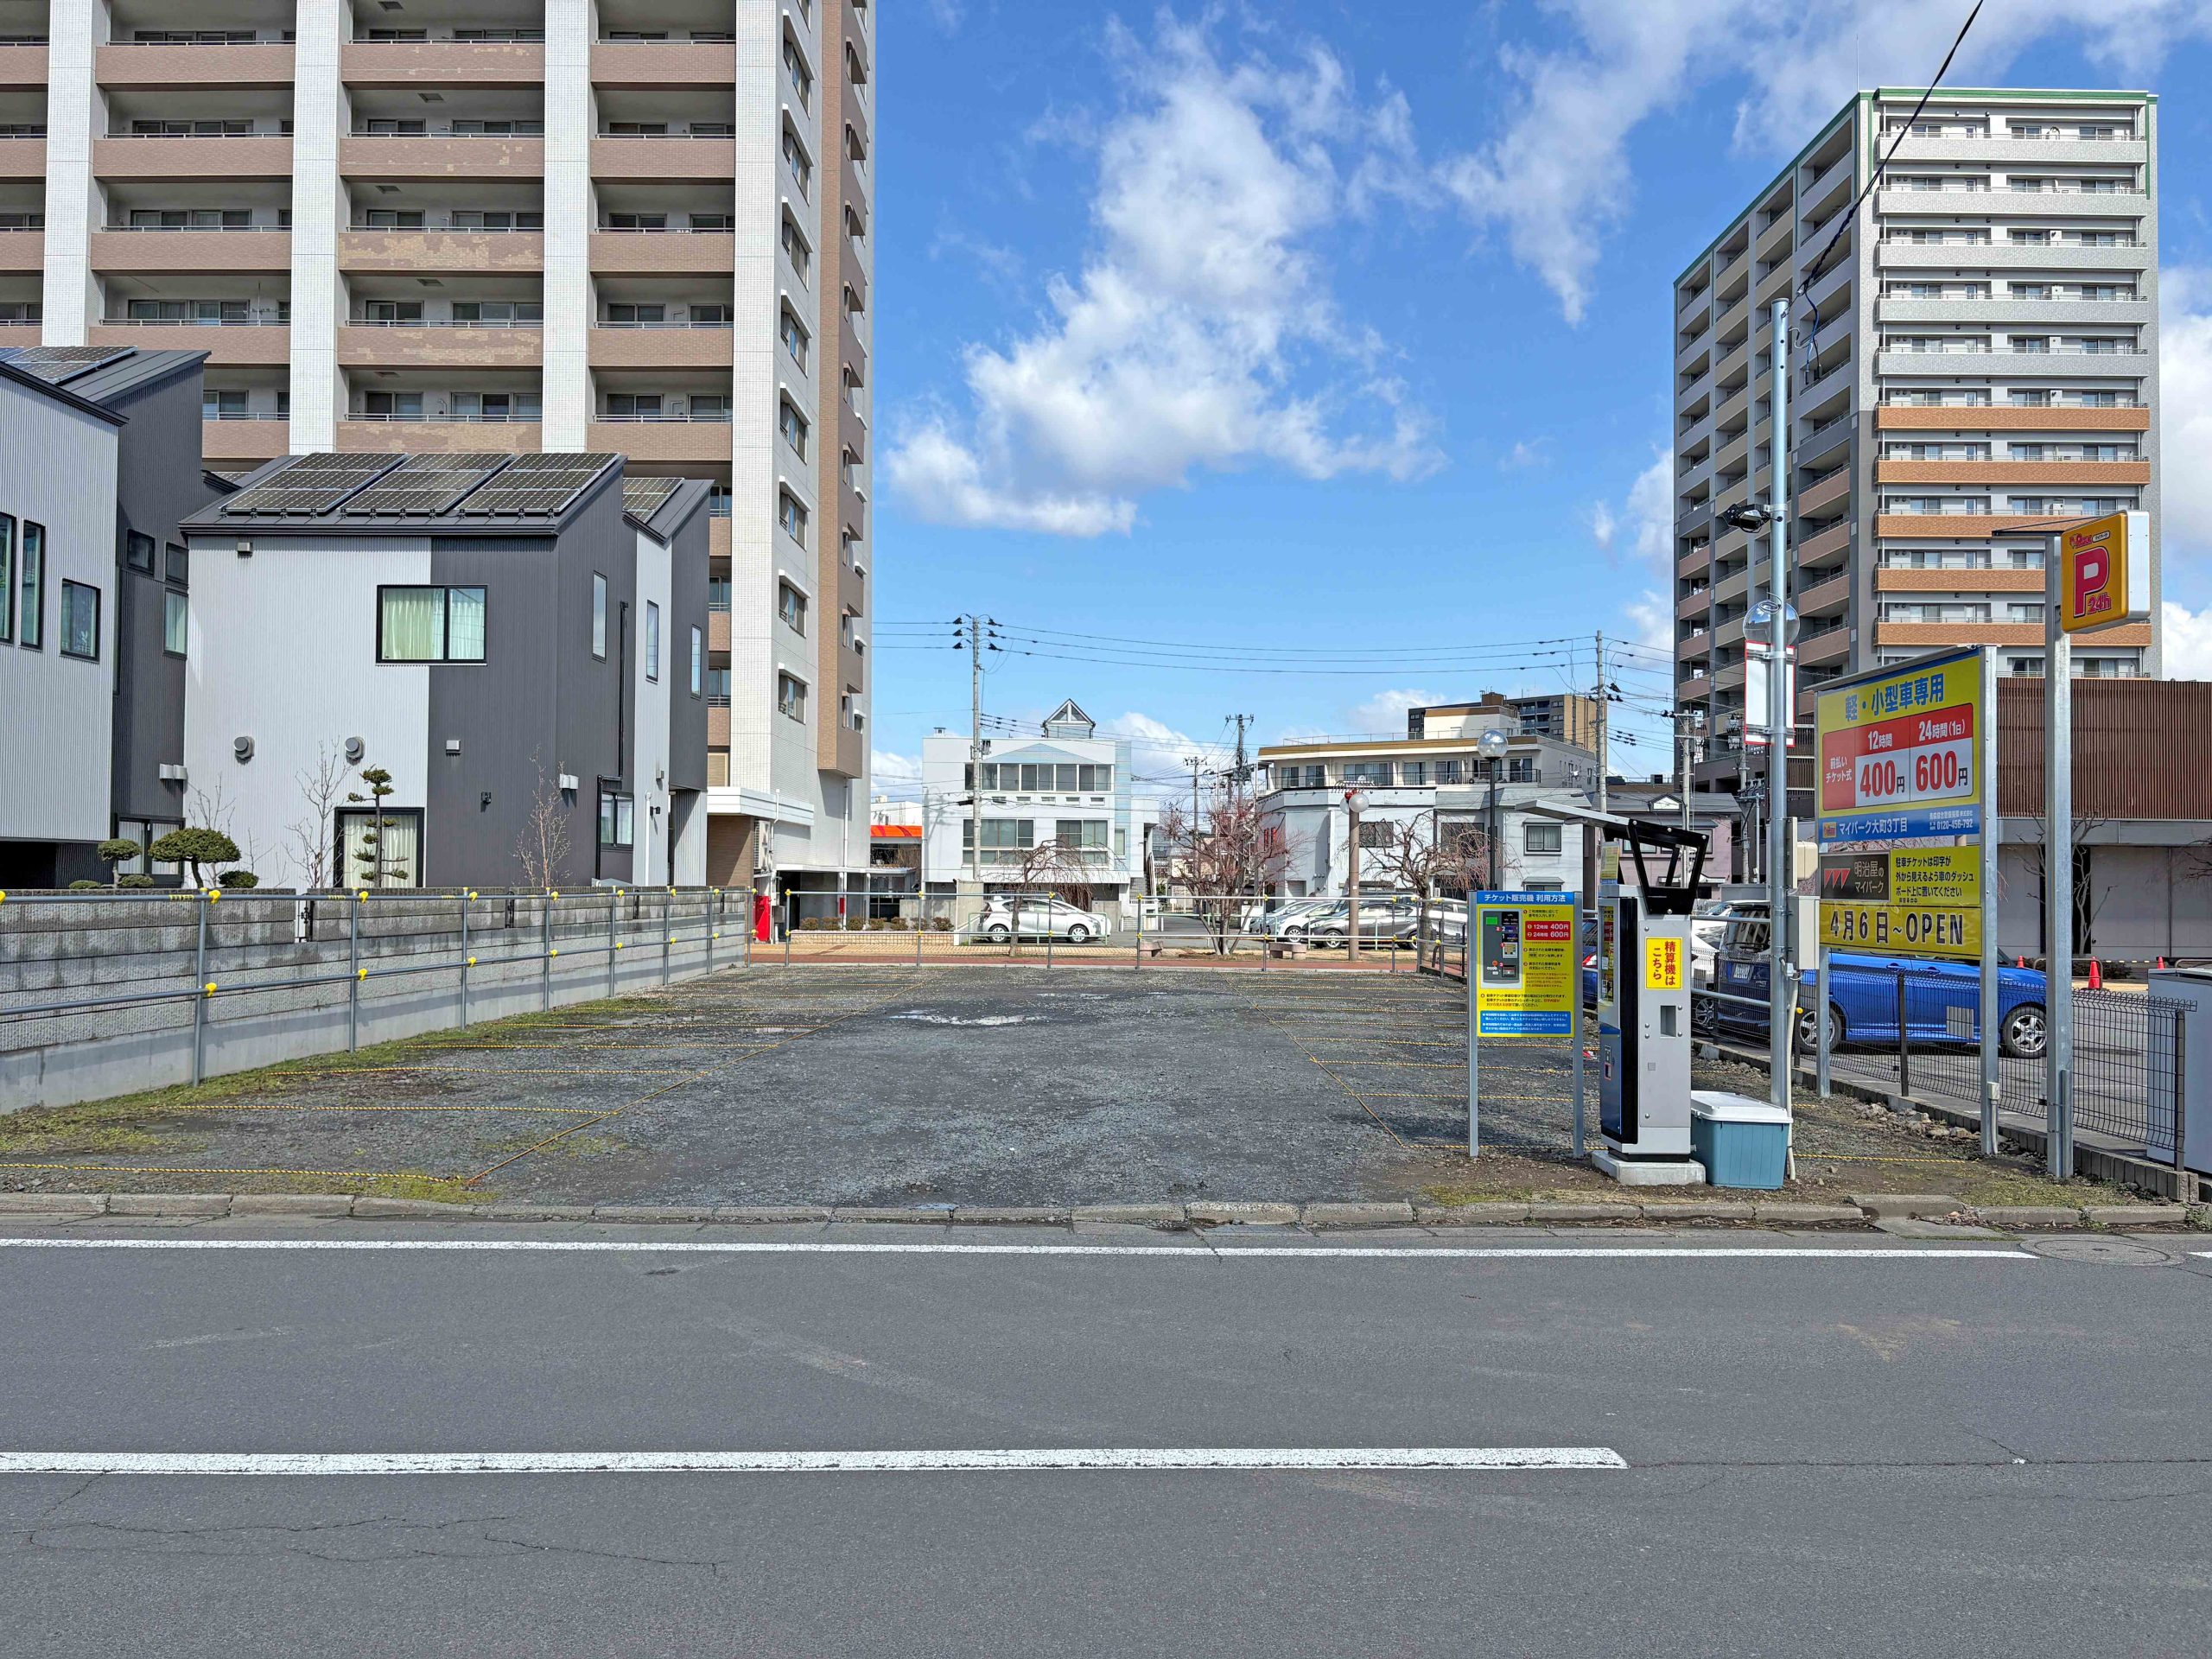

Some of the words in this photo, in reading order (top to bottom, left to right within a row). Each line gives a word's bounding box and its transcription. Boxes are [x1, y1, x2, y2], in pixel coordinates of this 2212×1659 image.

[2074, 546, 2109, 618] P
[2087, 592, 2112, 614] 24h
[1845, 673, 1944, 721] 軽・小型車専用
[1868, 730, 1892, 750] 12時間
[1830, 756, 1847, 769] 前払い
[1916, 750, 1968, 791] 600円
[1826, 768, 1853, 784] チケット式
[1859, 760, 1905, 798] 400円
[1839, 817, 1908, 835] マイパーク大町3丁目
[1936, 818, 1974, 830] 0120-456-792
[1854, 861, 1885, 877] 明治屋の
[1896, 855, 1951, 868] 駐車チケットは印字が
[1896, 871, 1974, 882] 外から見えるよう車のダッシュ
[1854, 880, 1884, 893] マイパーク
[1896, 886, 1962, 897] ボード上に置いてください
[1653, 948, 1662, 980] こちら
[1664, 941, 1675, 986] 精算機は
